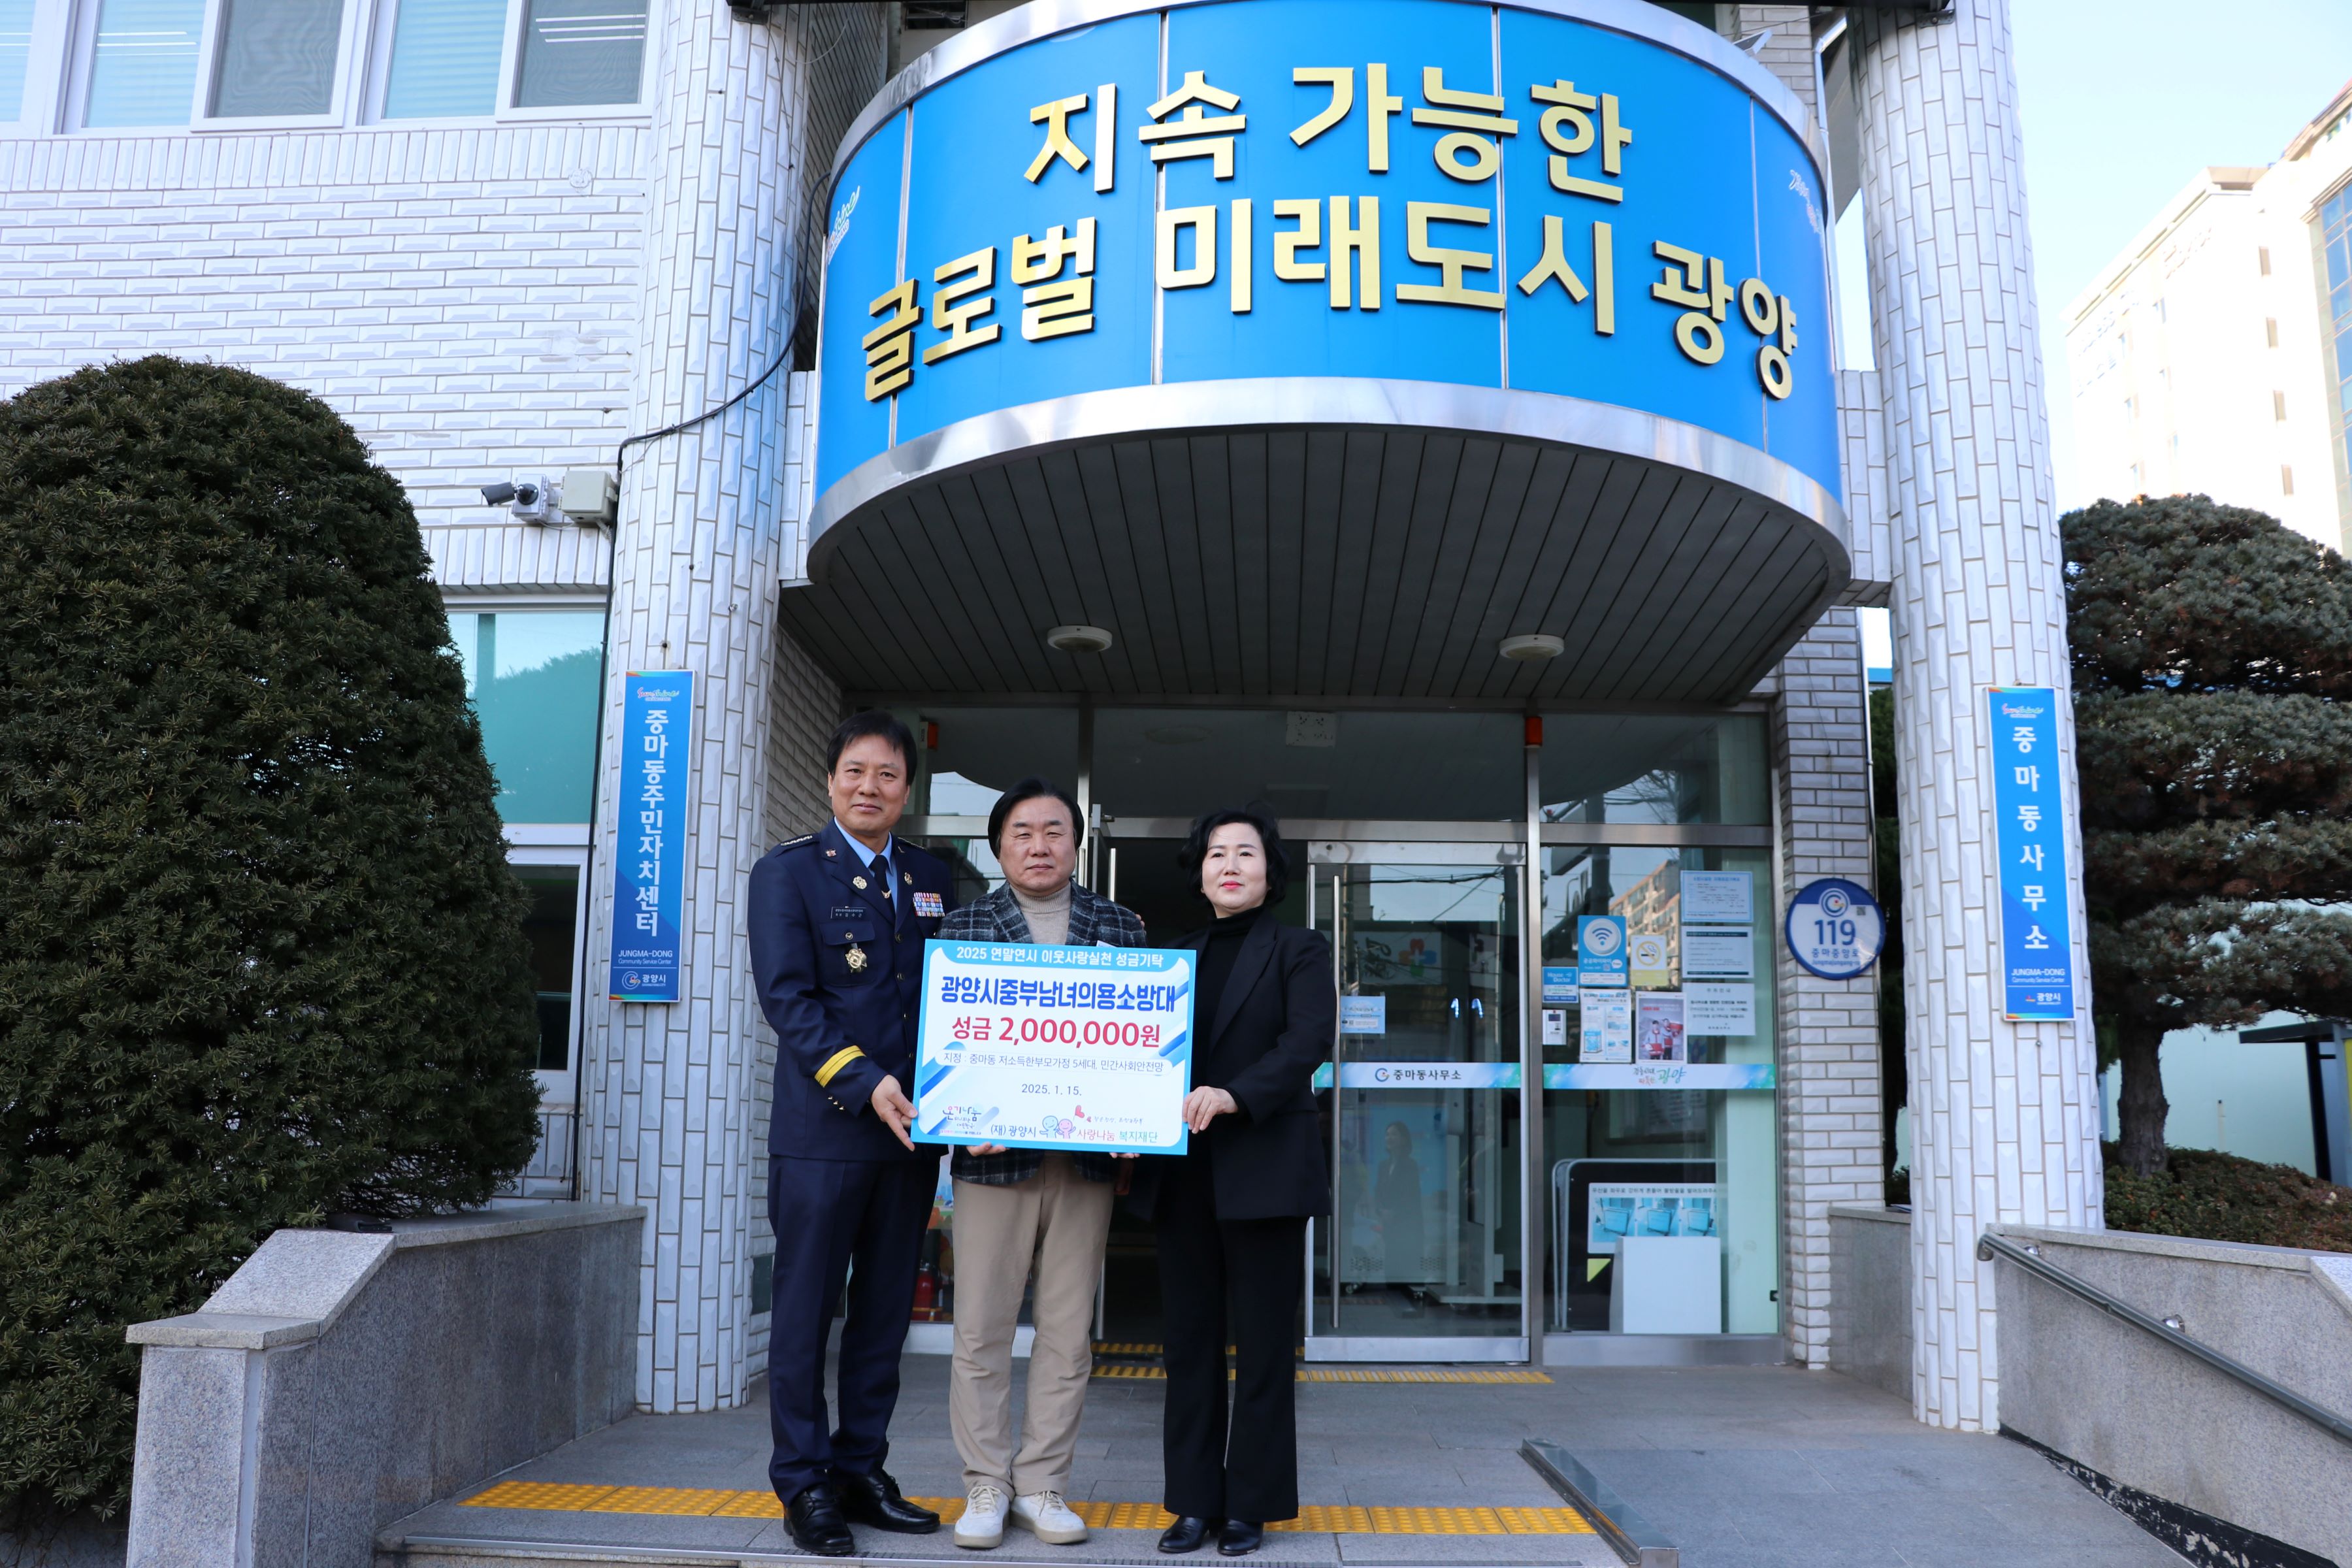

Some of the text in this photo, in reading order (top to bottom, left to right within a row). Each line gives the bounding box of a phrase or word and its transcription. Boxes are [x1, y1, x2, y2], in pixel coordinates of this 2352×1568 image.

[1023, 69, 1247, 193] 지속
[1290, 62, 1633, 203] 가능한
[862, 216, 1098, 402] 글로벌
[1158, 195, 1614, 337] 미래도시
[1651, 240, 1799, 400] 광양
[635, 710, 669, 937] 중마동주민자치센터
[2012, 727, 2050, 949] 중마동사무소
[1814, 919, 1855, 945] 119
[956, 947, 1164, 968] 2025 연말연시 이웃사랑실천 성금기탁
[642, 974, 666, 983] 광양시
[941, 976, 1175, 1012] 광양시중부남녀의용소방대
[2037, 993, 2061, 1002] 광양시
[952, 1017, 1160, 1048] 성금 2,000,000원
[944, 1053, 961, 1064] 지정
[970, 1054, 996, 1065] 중마동
[999, 1055, 1070, 1069] 저소득한부모가정
[1101, 1060, 1164, 1072] 민간사회안전망
[1393, 1069, 1462, 1081] 중마동사무소
[1656, 1066, 1687, 1084] 광양
[1022, 1083, 1051, 1094] 2025.
[1068, 1086, 1082, 1096] 15.
[943, 1105, 981, 1122] 온기나눔
[990, 1124, 1006, 1136] (재)
[1009, 1126, 1037, 1138] 광양시
[1077, 1129, 1115, 1141] 사랑나눔
[1119, 1131, 1158, 1143] 복지재단
